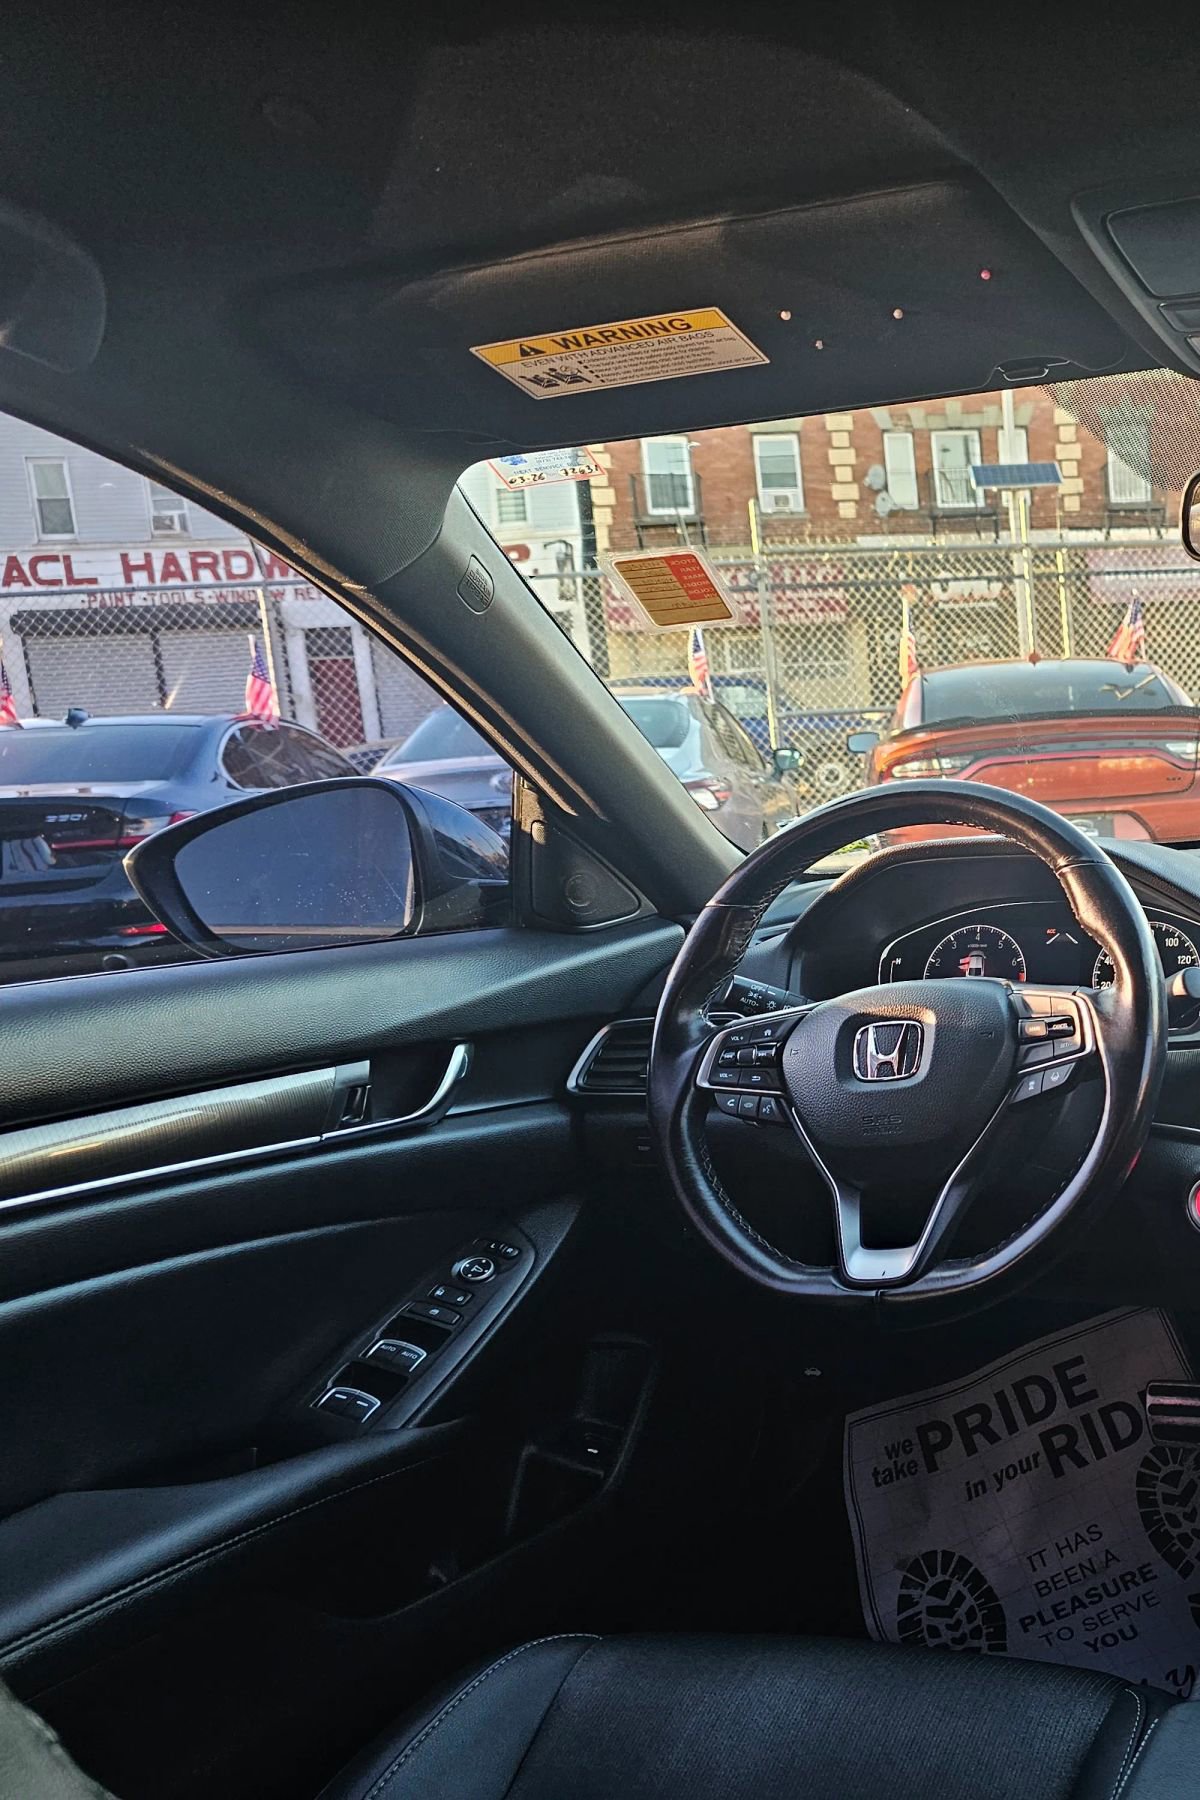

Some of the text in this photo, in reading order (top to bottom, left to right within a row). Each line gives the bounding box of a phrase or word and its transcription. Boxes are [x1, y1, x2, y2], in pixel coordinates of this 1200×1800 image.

[552, 318, 693, 349] WARNING
[521, 330, 715, 368] EVEN WITH ADVANCED AIR BAGS
[2, 549, 299, 588] ACL HARDW
[147, 589, 205, 607] TOOLS
[215, 588, 285, 605] WINDW
[951, 941, 957, 949] 3
[975, 933, 981, 942] 4
[998, 941, 1004, 949] 5
[1165, 937, 1179, 948] 100
[935, 959, 941, 967] 2
[1011, 958, 1017, 967] 6
[1177, 955, 1192, 965] 120
[1101, 980, 1112, 989] 20
[740, 997, 756, 1007] AUTO
[380, 1344, 397, 1352] AUTO
[401, 1350, 418, 1359] AUTO
[916, 1355, 1099, 1474] PRIDE
[884, 1437, 914, 1460] we
[965, 1389, 1147, 1501] in your RID
[871, 1458, 919, 1488] take
[1026, 1523, 1103, 1573] IT HAS
[1034, 1549, 1121, 1598] BEEN A
[1018, 1562, 1158, 1634] PLEASURE
[1038, 1590, 1161, 1648] TO SERVE
[1083, 1623, 1139, 1653] YOU
